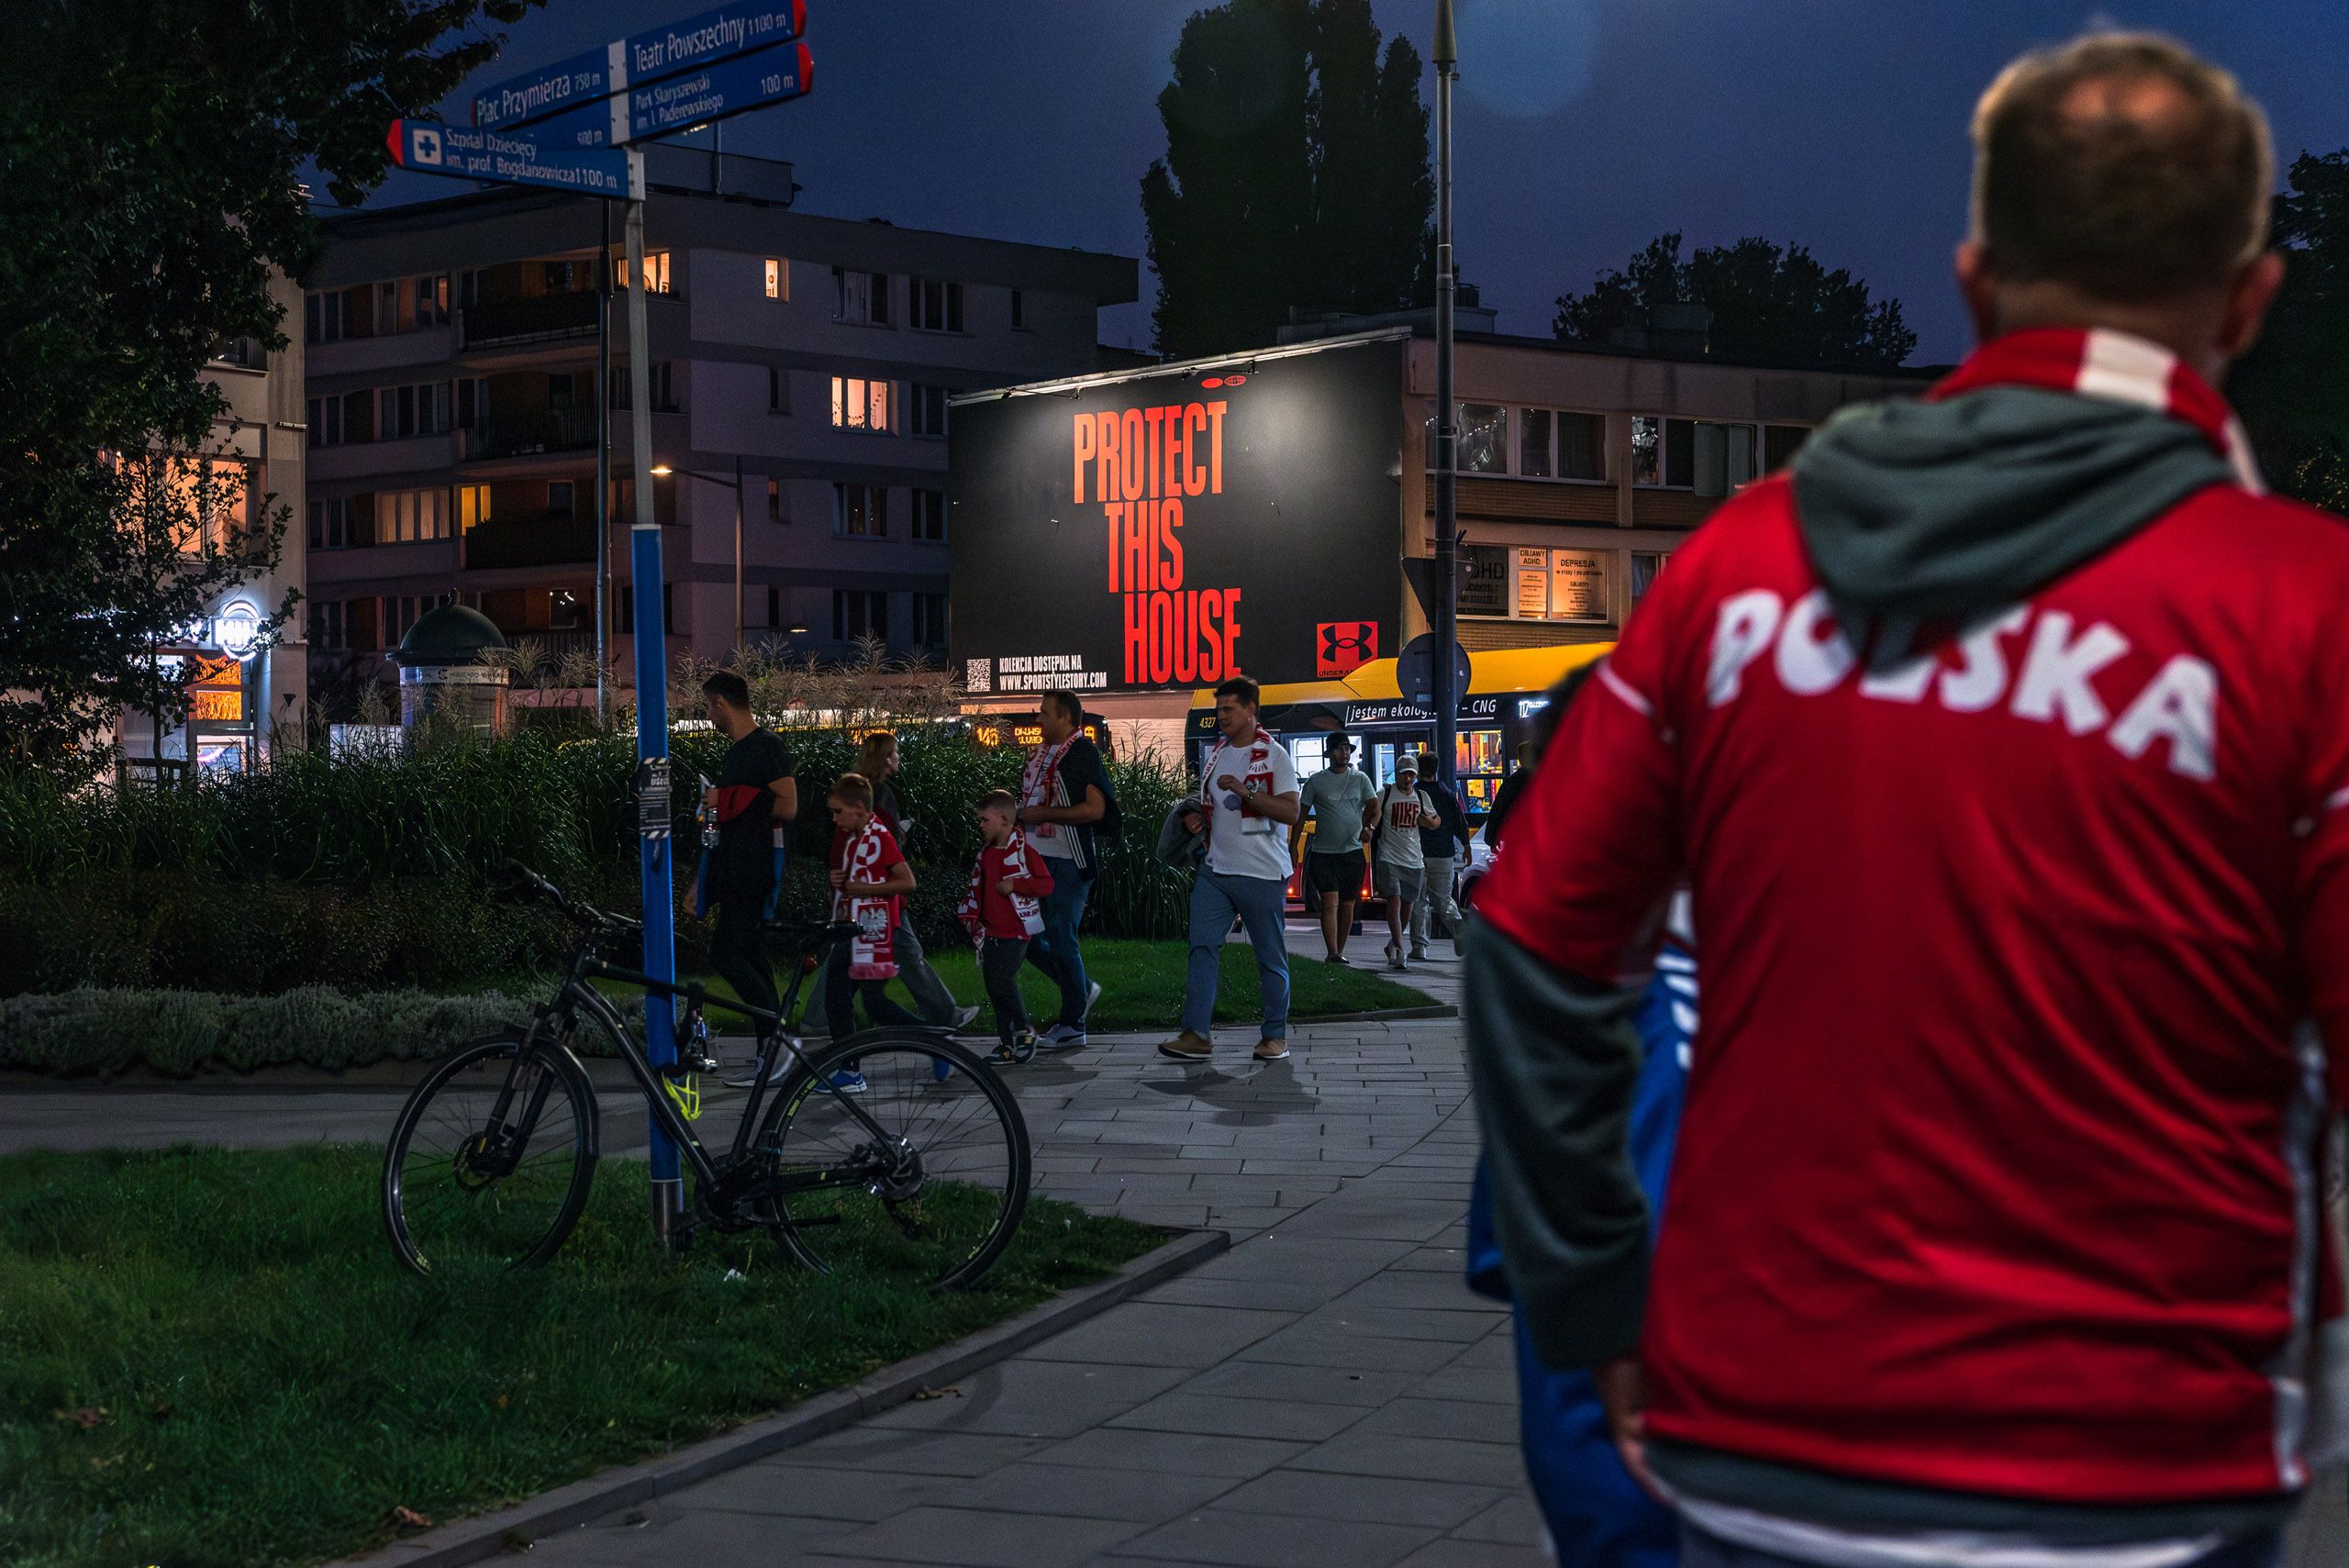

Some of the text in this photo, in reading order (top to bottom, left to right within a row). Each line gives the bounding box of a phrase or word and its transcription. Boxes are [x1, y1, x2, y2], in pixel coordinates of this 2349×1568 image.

[634, 14, 786, 72] Teatr Powszechny 1100 m
[761, 74, 794, 95] 100 m
[477, 72, 601, 127] Plac Przymierza 750 m
[635, 91, 653, 110] Park
[445, 128, 484, 151] Szpital
[468, 155, 493, 173] prof.
[607, 175, 618, 189] m
[1074, 401, 1227, 504] PROTECT
[1105, 498, 1184, 594] THIS
[1560, 559, 1596, 568] DEPRESJA
[1124, 588, 1241, 684] HOUSE
[999, 655, 1083, 673] KOLEKCJA DOSTĘPNA NA
[999, 673, 1108, 690] WWW.SPORTSTYLESTORY.COM
[1350, 706, 1387, 721] jestem
[1473, 699, 1497, 713] CNG
[1199, 717, 1216, 728] 4327
